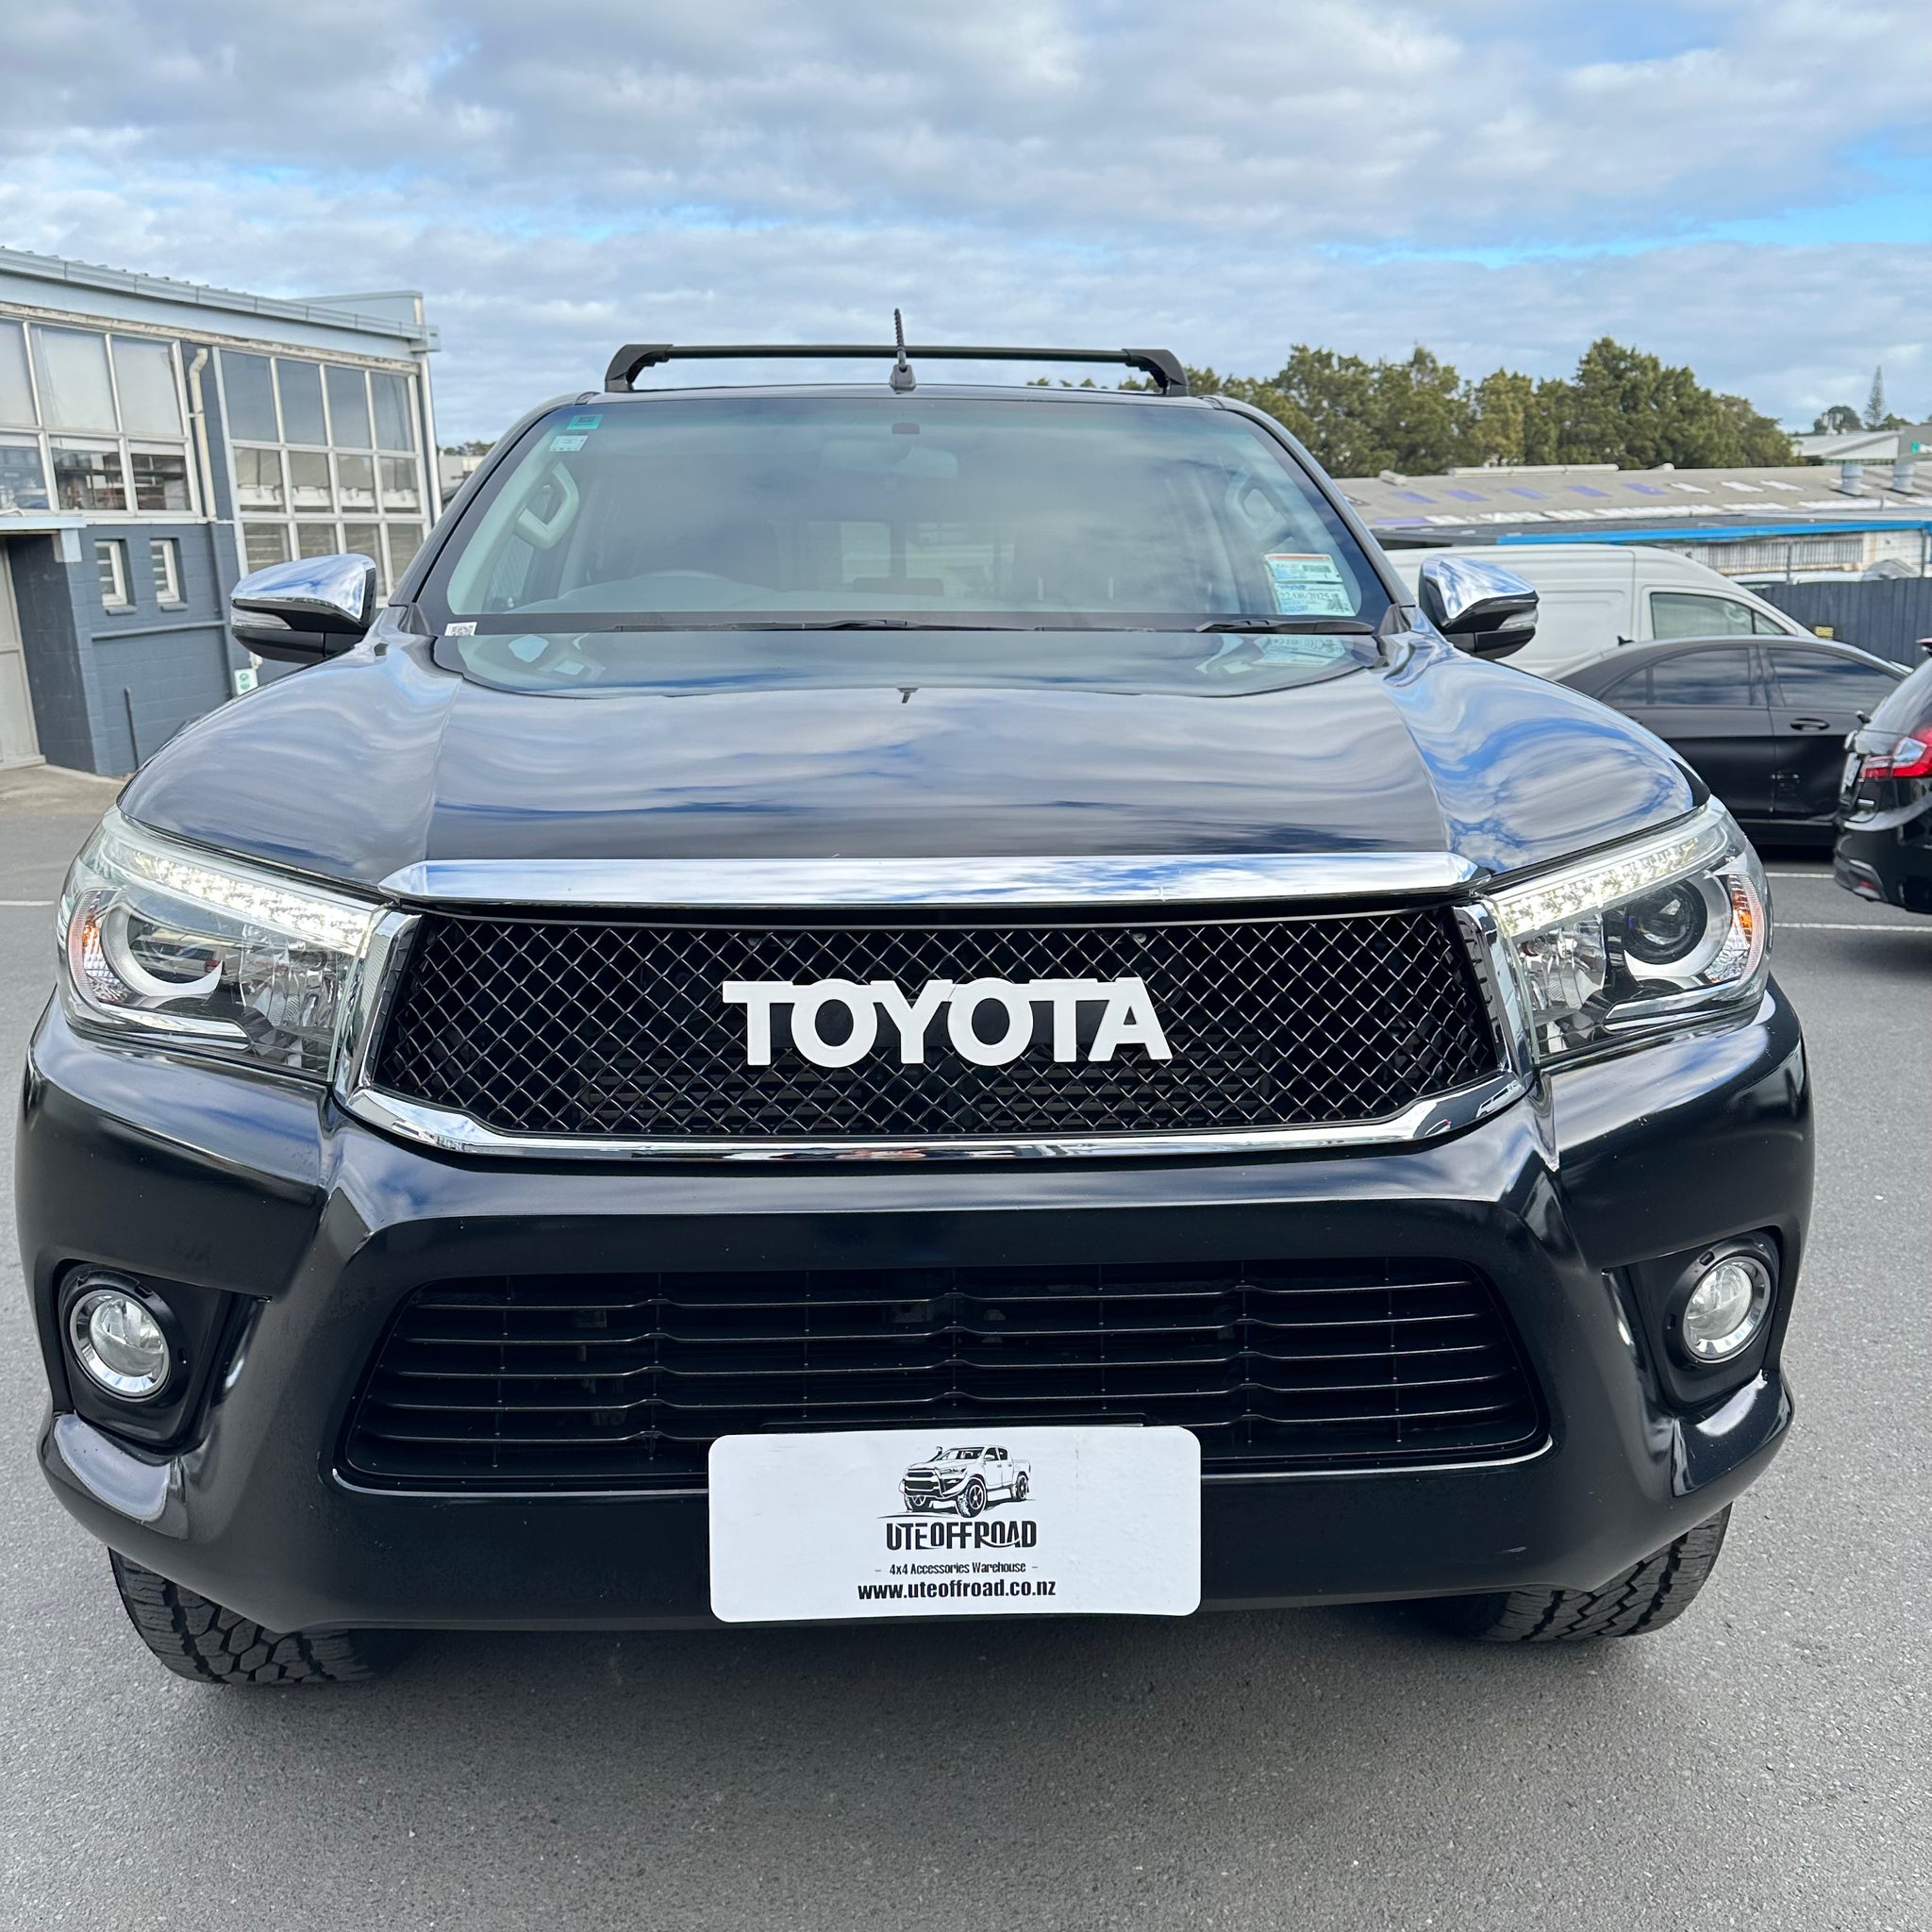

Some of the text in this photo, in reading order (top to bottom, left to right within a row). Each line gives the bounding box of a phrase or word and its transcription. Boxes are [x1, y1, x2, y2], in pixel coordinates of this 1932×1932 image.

[723, 977, 1173, 1067] TOYOTA
[889, 1562, 1026, 1575] 4x4 Accessories Warehouse
[858, 1579, 1057, 1600] www.uteoffroad.co.nz
